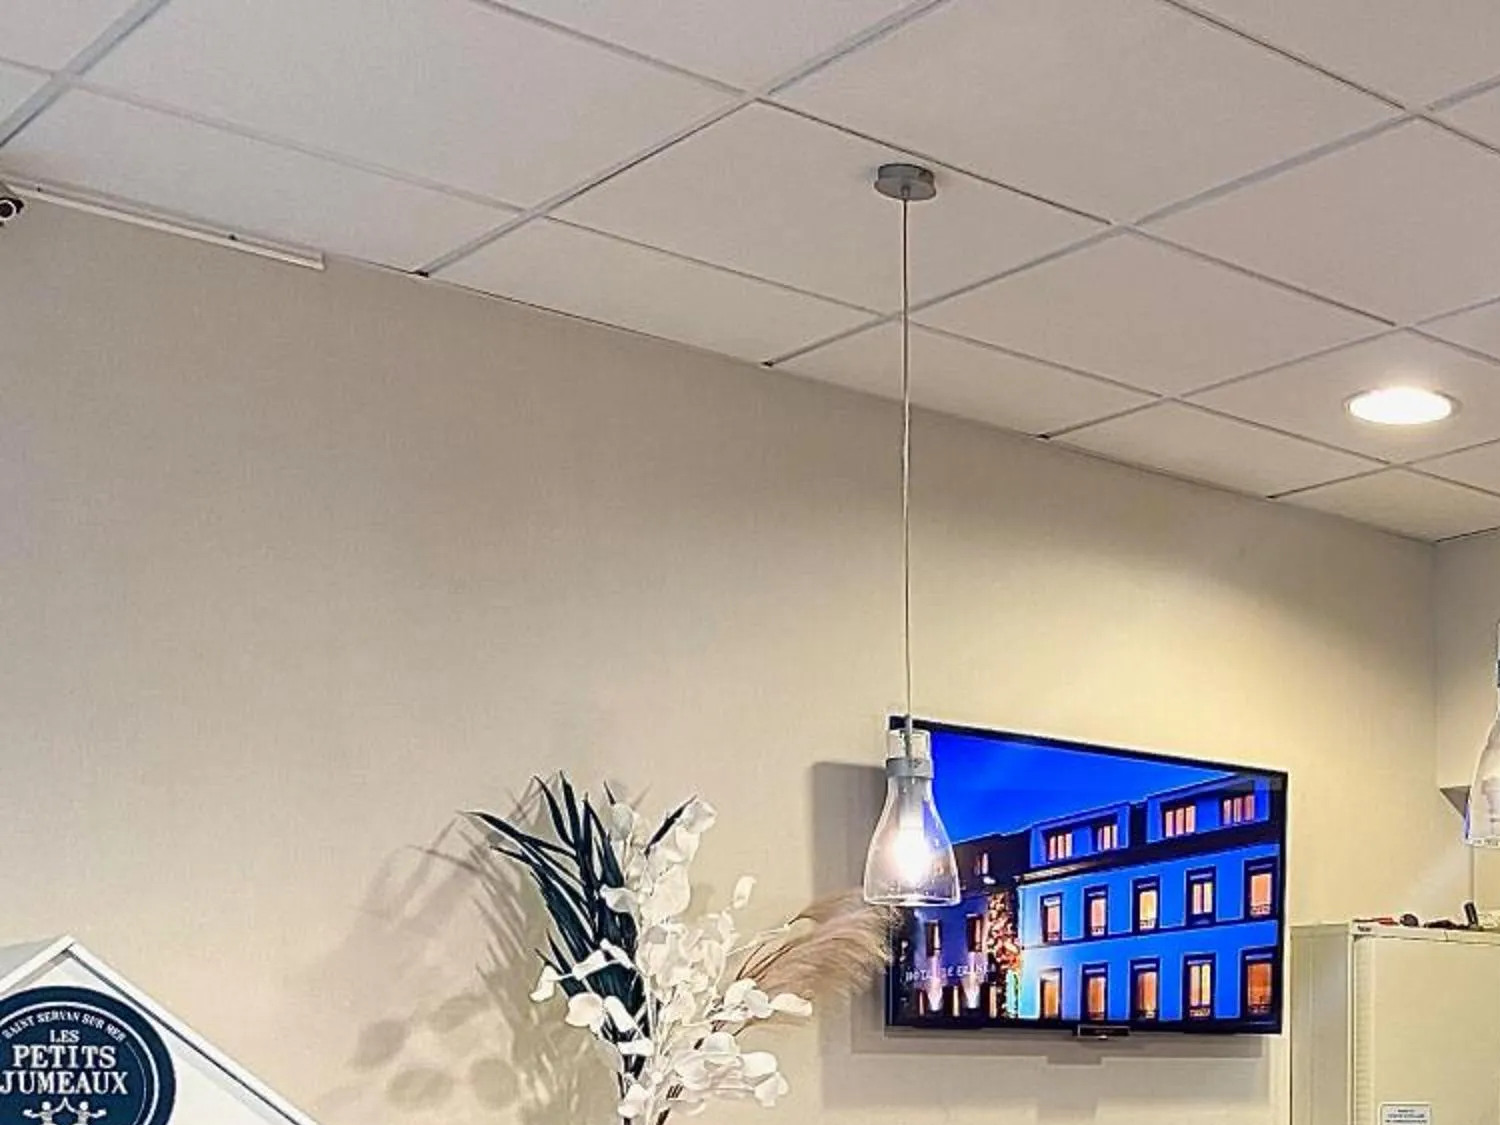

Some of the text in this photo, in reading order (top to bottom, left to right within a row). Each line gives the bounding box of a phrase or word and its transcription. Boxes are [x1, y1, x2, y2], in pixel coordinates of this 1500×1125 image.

[1, 1010, 126, 1042] SAINT SERVAN SUR MER
[50, 1029, 80, 1043] LES
[12, 1044, 117, 1070] PETITS
[0, 1070, 129, 1095] JUMEAUX
